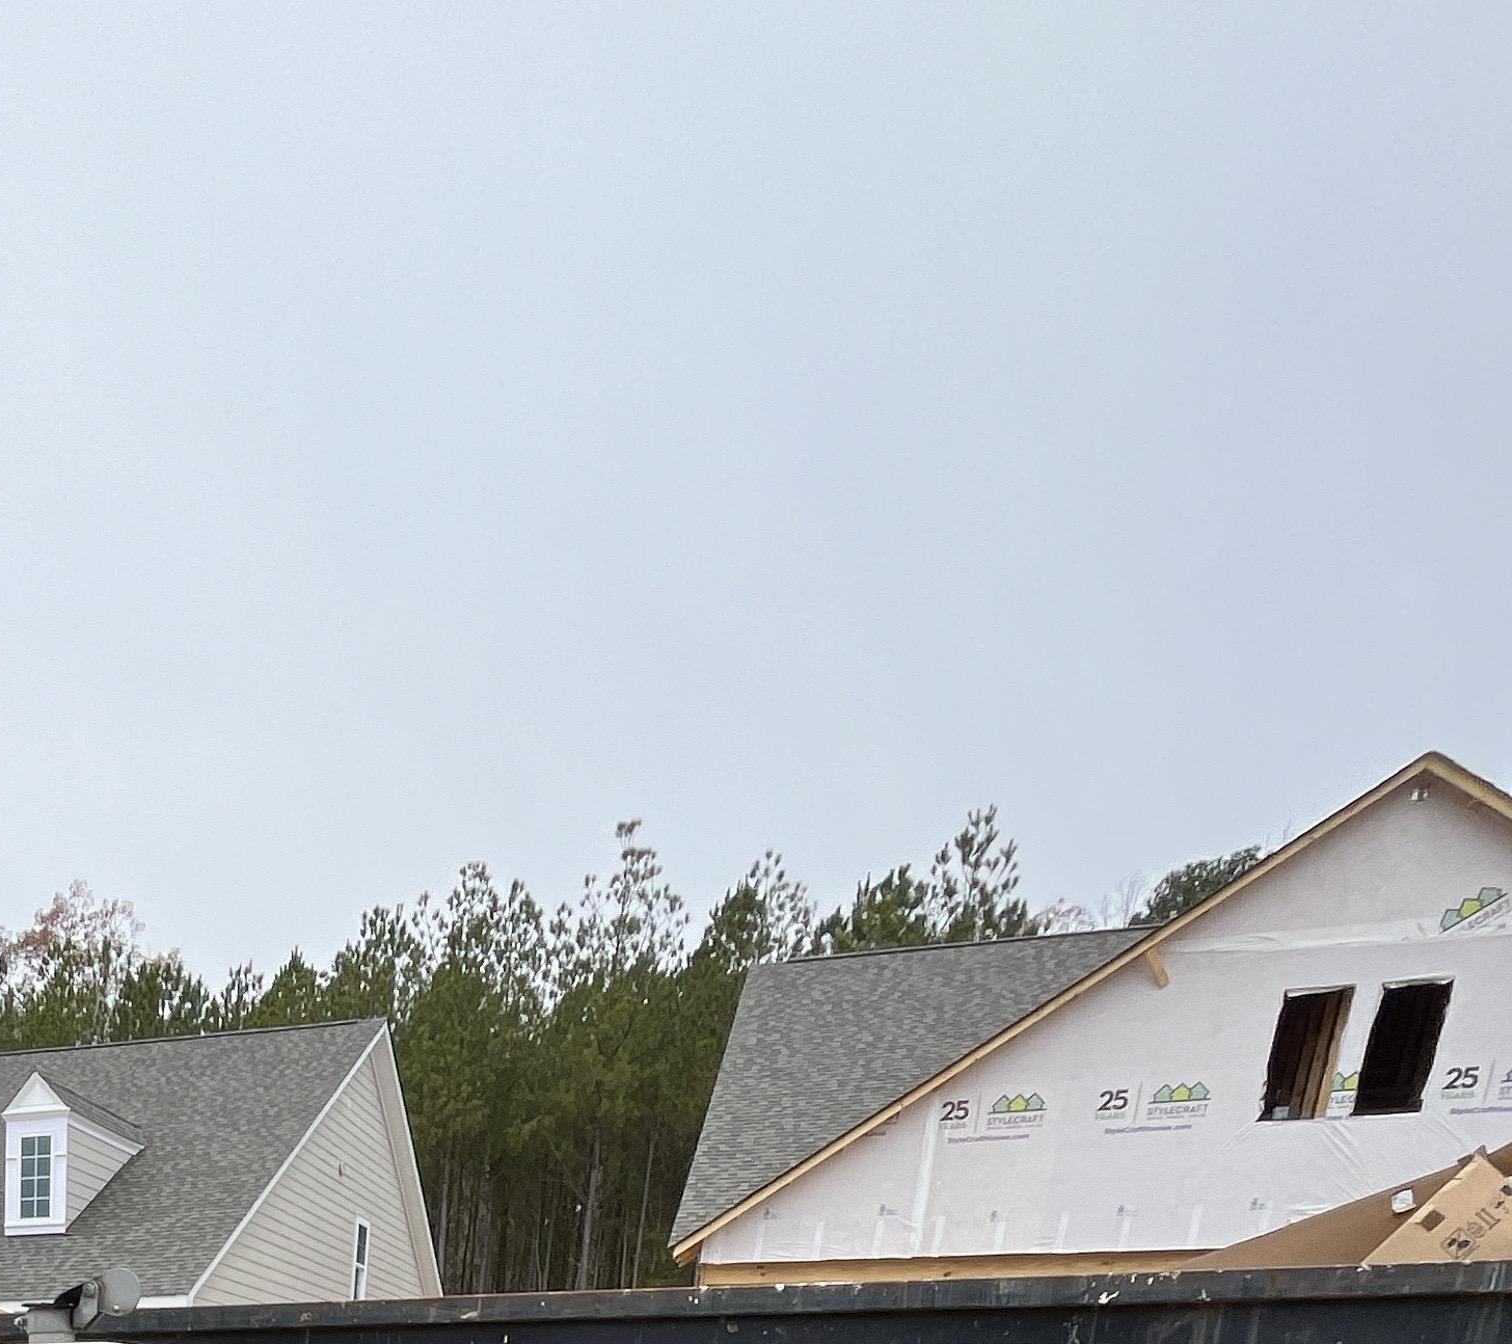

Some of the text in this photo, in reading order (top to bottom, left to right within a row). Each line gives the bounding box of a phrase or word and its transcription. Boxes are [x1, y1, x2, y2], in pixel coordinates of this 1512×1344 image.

[1441, 1066, 1480, 1090] 25
[939, 1100, 970, 1122] 25
[1097, 1088, 1129, 1112] 25
